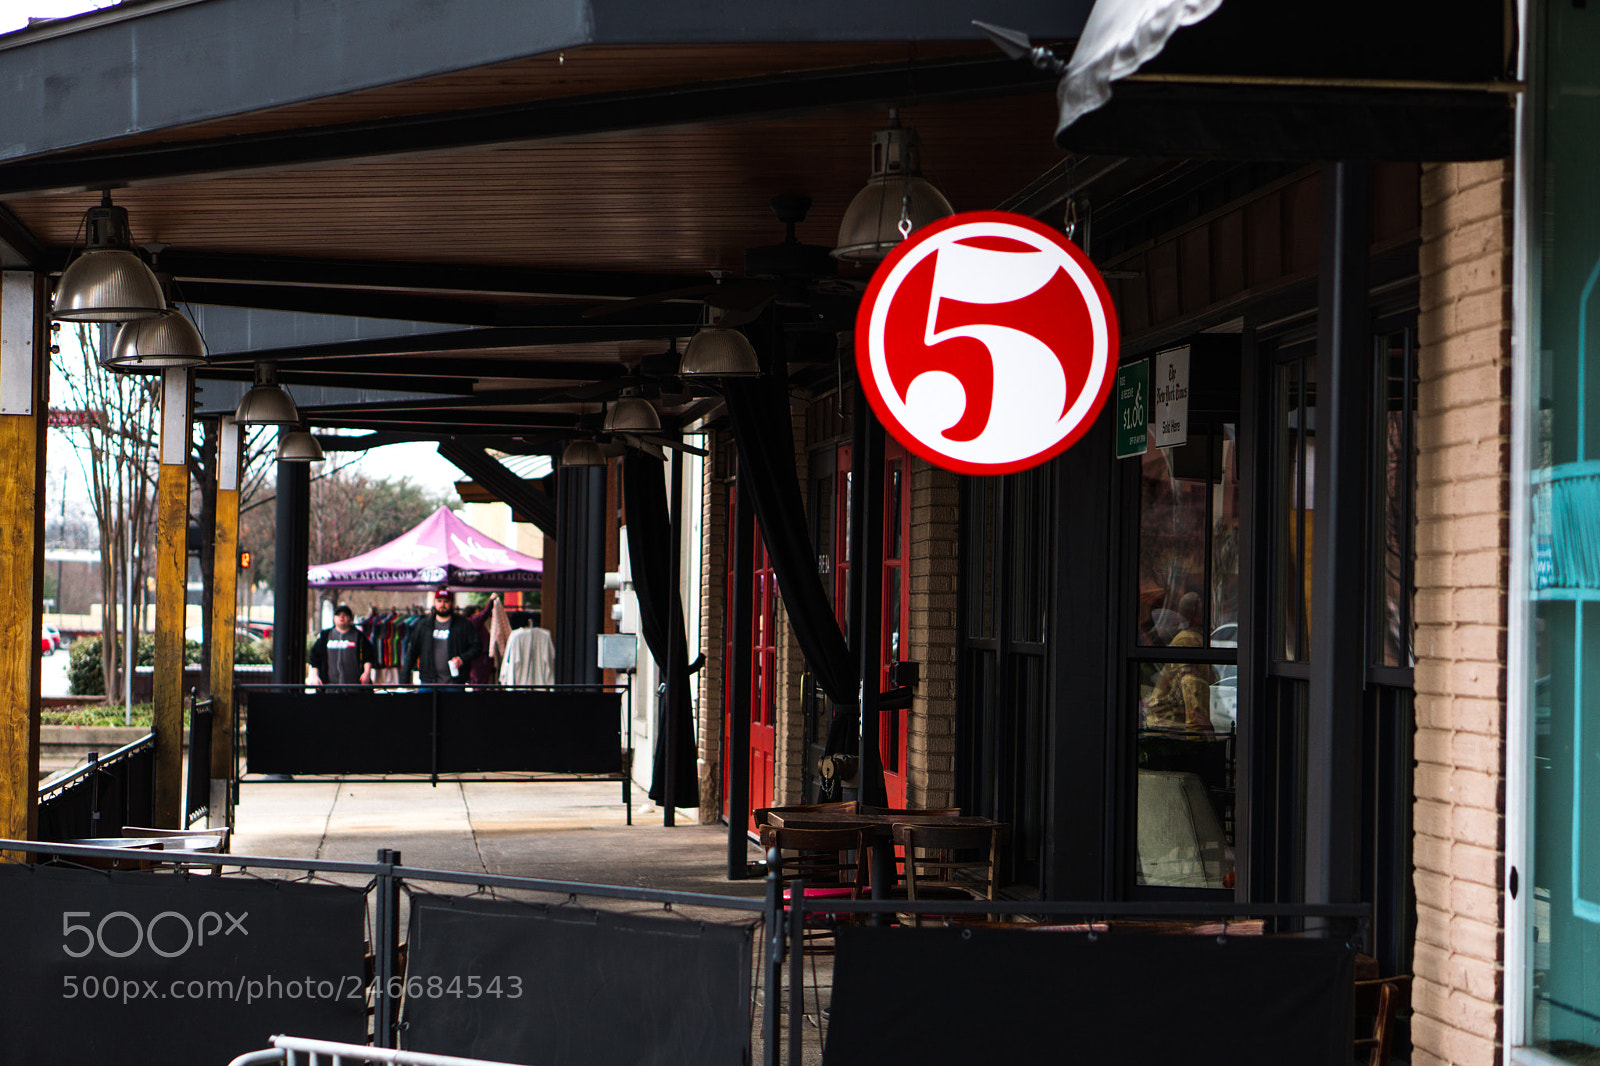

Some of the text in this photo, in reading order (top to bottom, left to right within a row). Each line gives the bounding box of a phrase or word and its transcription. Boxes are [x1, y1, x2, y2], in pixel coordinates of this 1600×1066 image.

[887, 230, 1072, 463] 5
[1175, 383, 1187, 401] Times
[1123, 405, 1144, 431] $1.00
